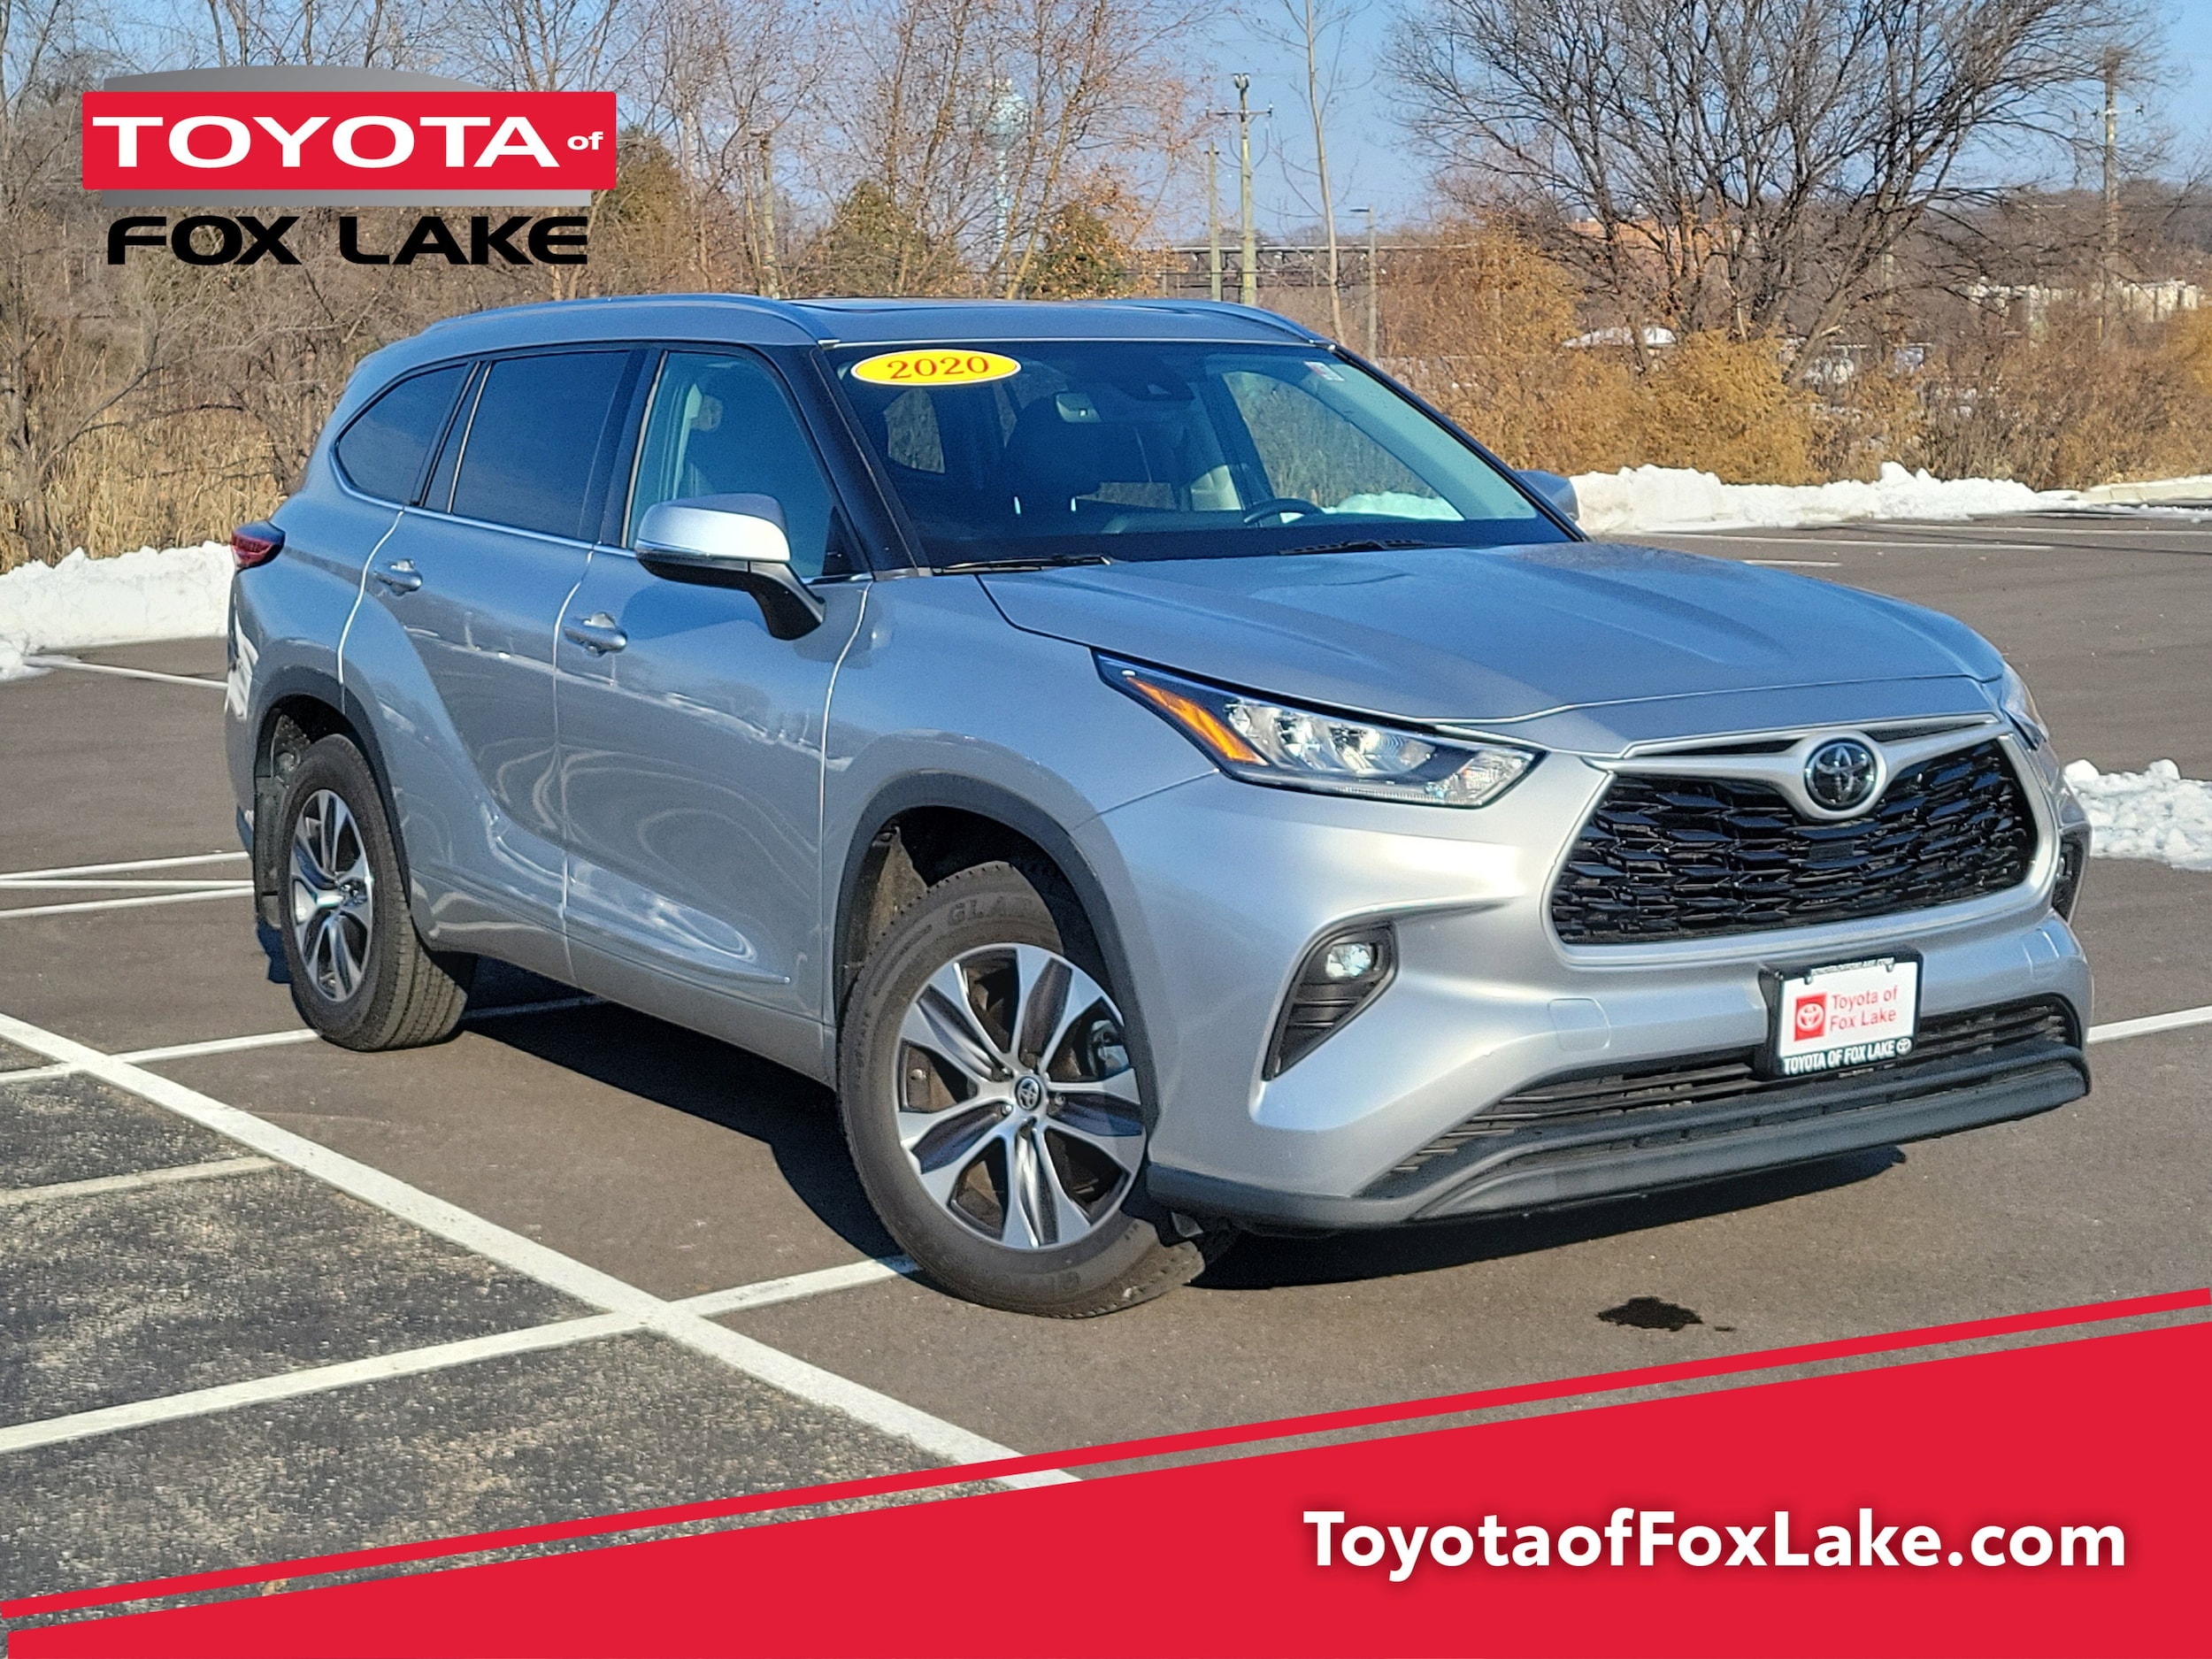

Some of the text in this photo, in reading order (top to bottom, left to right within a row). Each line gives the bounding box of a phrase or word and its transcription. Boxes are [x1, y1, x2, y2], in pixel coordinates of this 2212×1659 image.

[887, 356, 989, 380] 2020
[1832, 985, 1899, 1011] Toyota of
[1830, 1008, 1897, 1032] Fox Lake
[1784, 1040, 1895, 1075] TOYOTA OF FOX LAKE
